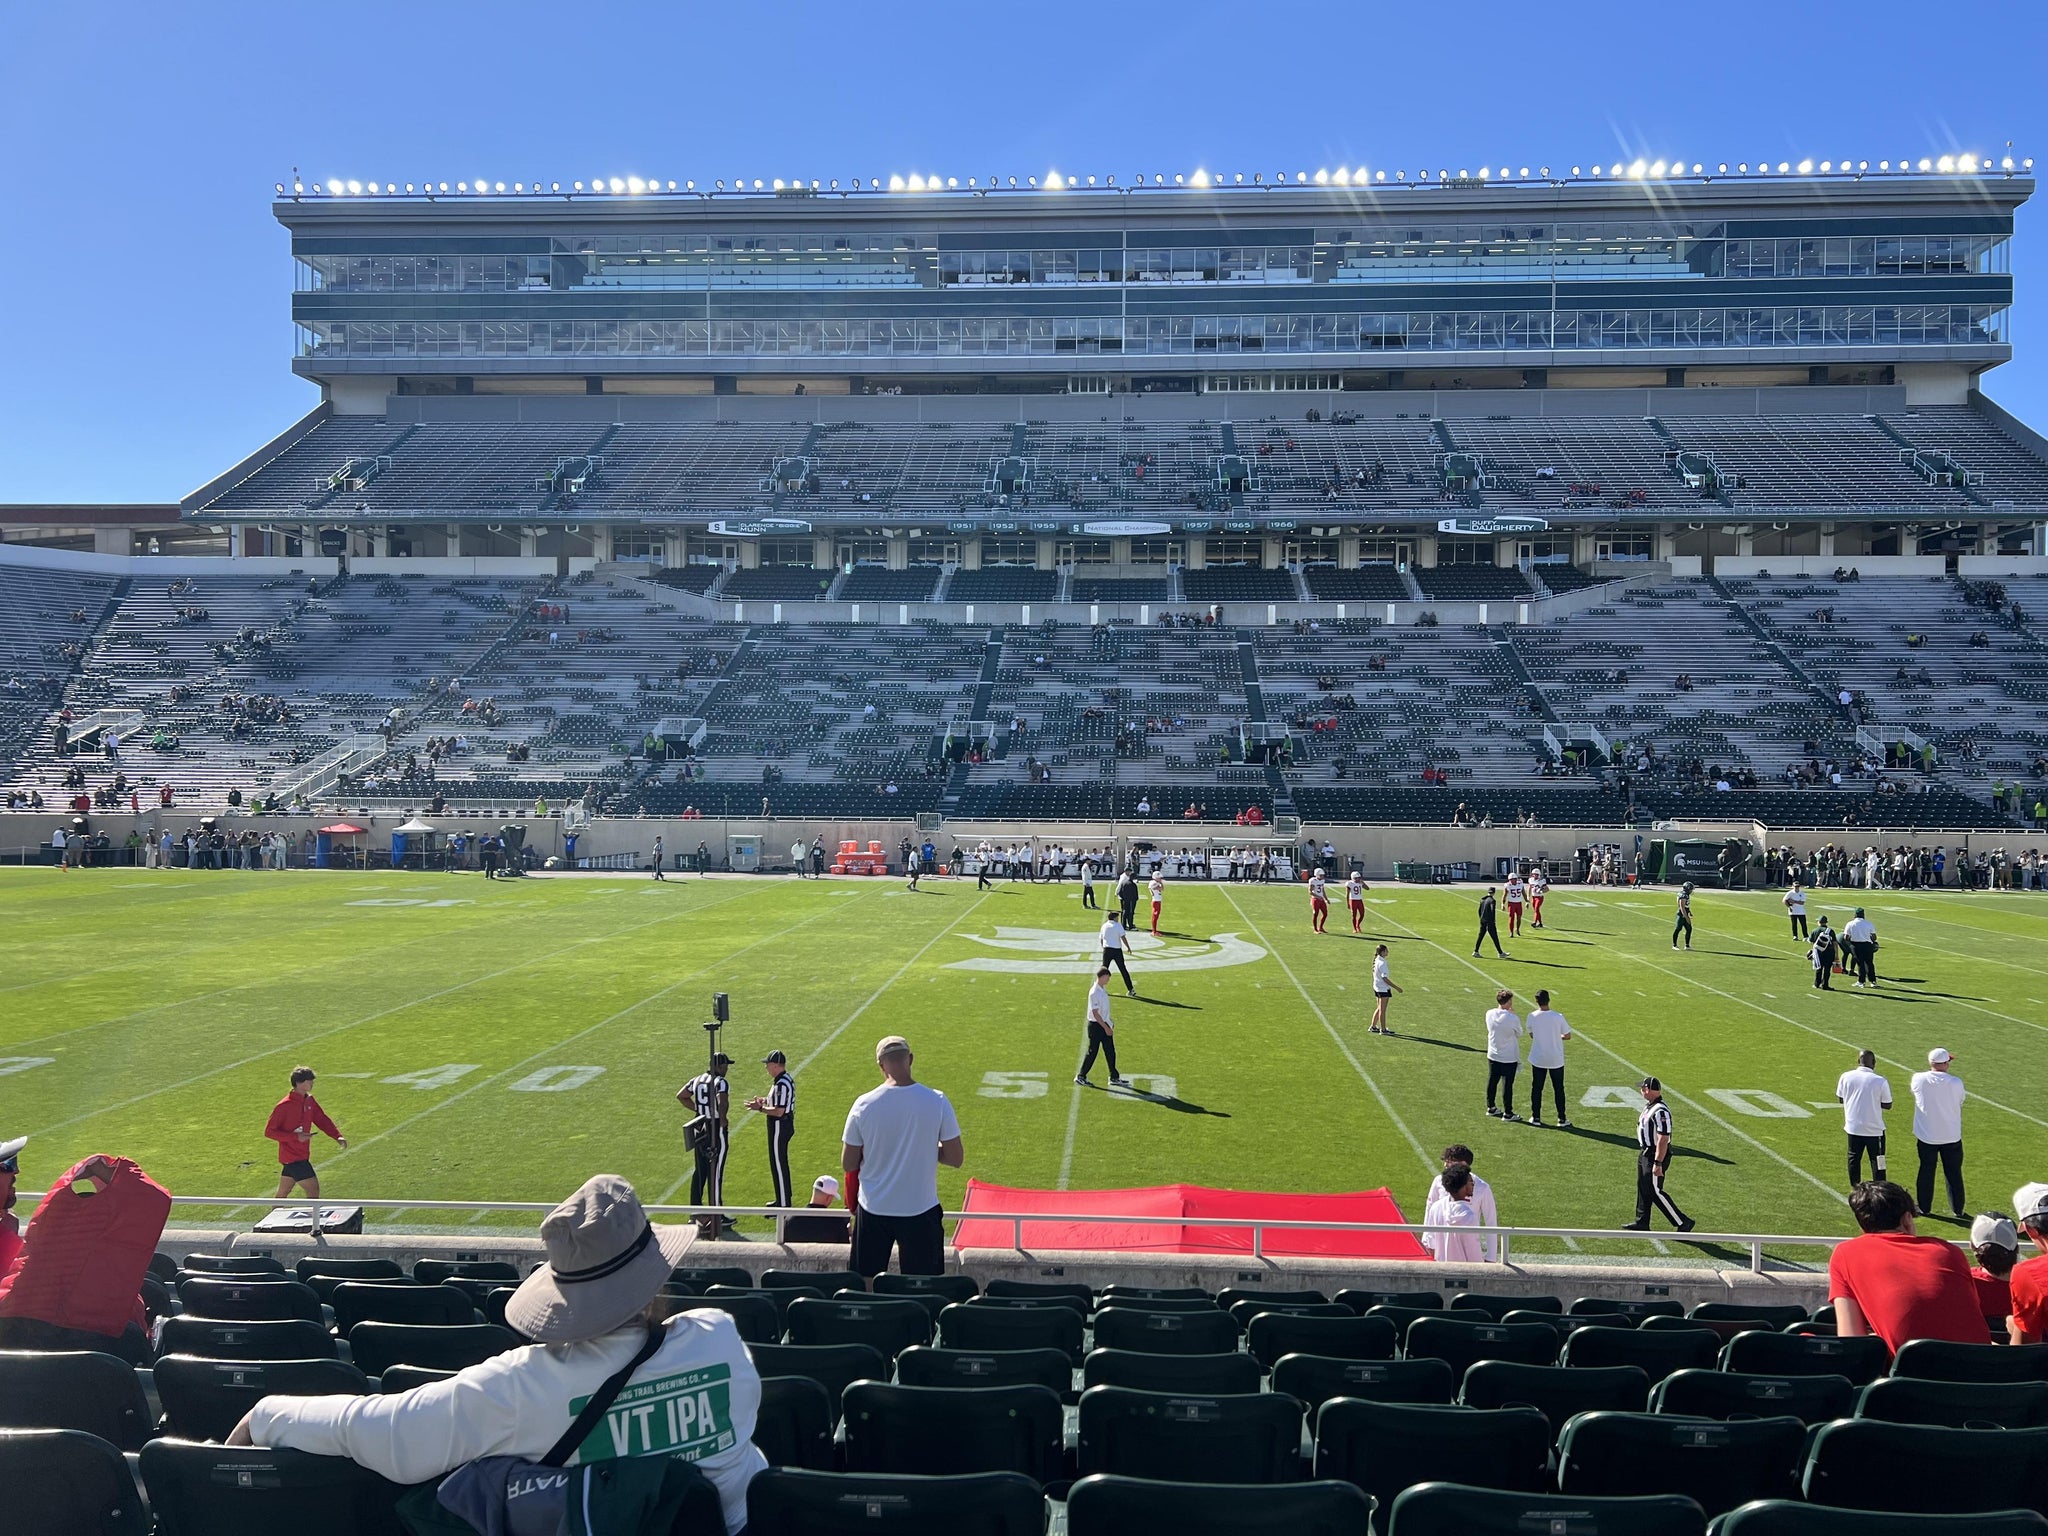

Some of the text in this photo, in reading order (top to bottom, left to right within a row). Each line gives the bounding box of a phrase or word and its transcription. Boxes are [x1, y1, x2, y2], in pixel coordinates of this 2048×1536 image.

[1073, 524, 1080, 532] S
[1444, 522, 1450, 530] S
[1510, 888, 1521, 898] 55
[616, 1389, 634, 1402] ONG
[634, 1384, 655, 1398] TRAIL
[656, 1376, 688, 1393] BREWING
[607, 1389, 717, 1458] VT IPA
